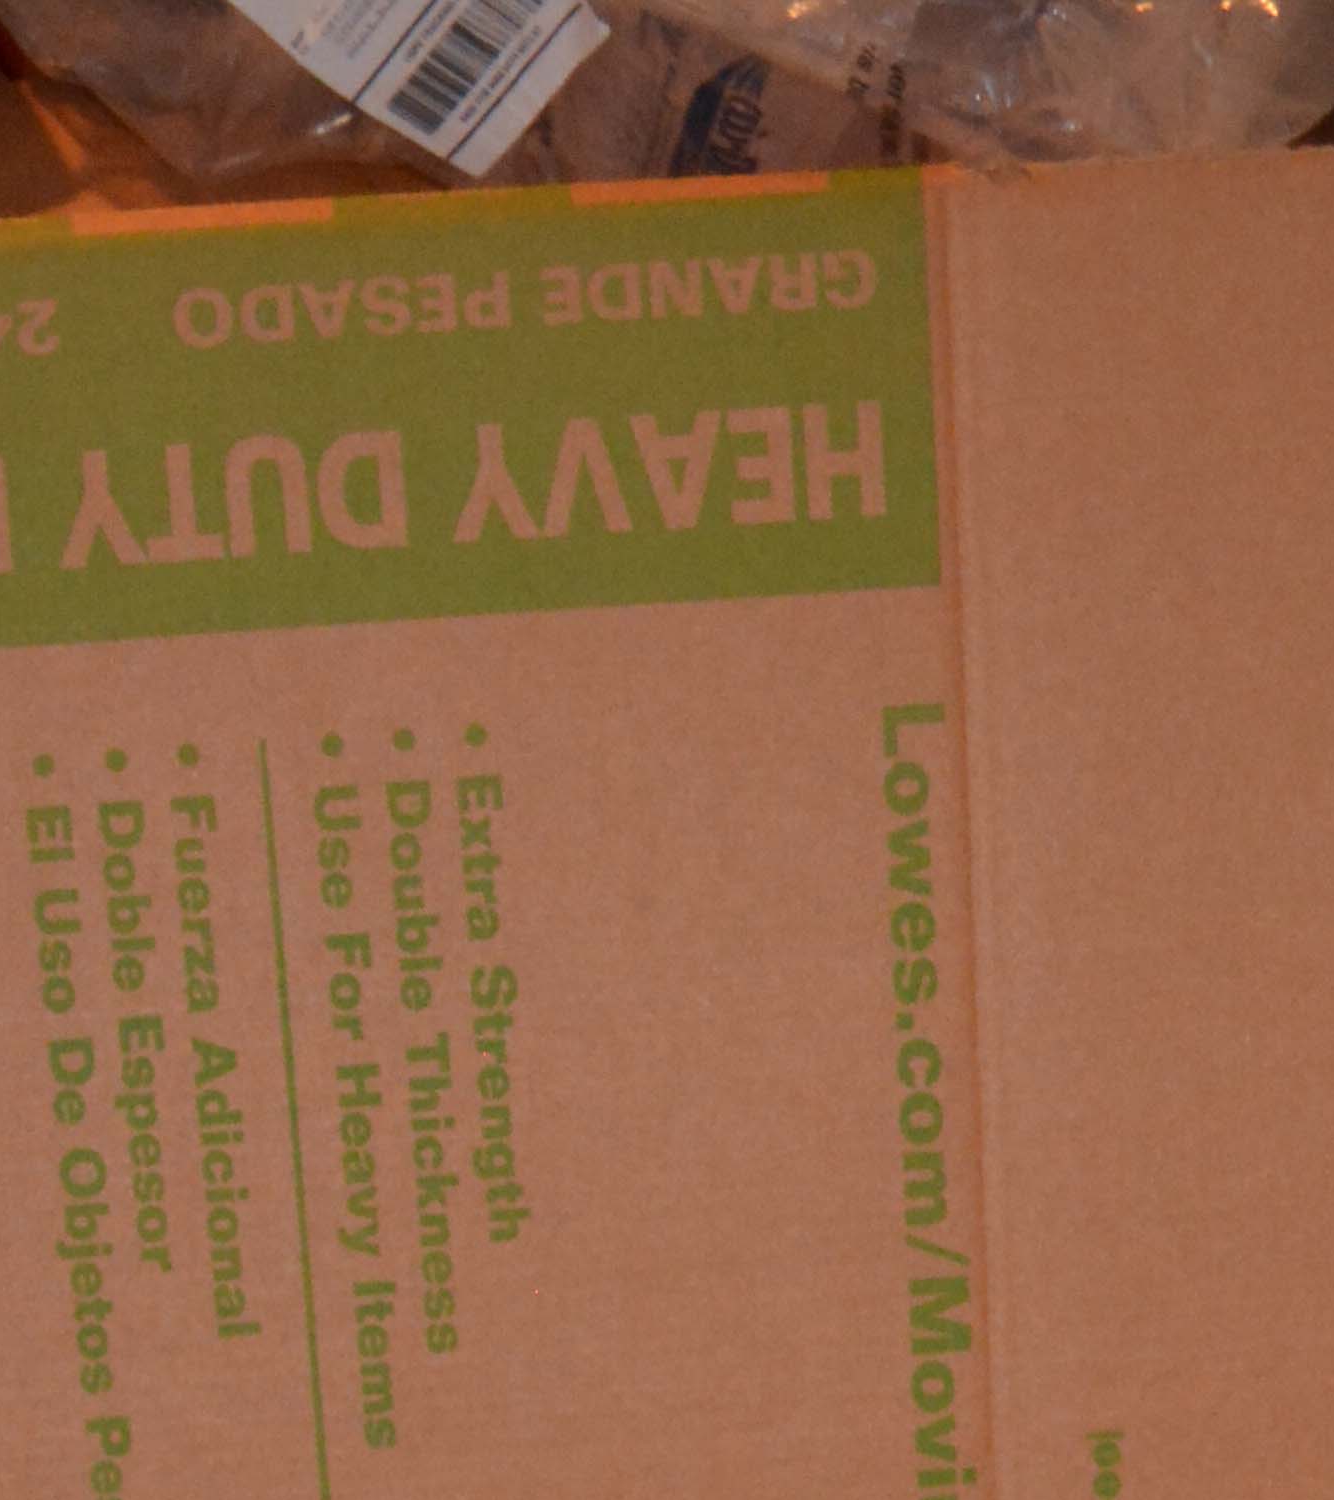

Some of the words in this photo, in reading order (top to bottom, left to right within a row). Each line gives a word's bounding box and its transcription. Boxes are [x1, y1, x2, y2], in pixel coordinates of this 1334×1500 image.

[171, 268, 513, 350] PESADO
[542, 249, 880, 320] GRANDE
[62, 432, 406, 571] DUTY
[456, 402, 886, 545] HEAVY
[25, 805, 75, 864] El
[97, 799, 156, 993] Doble
[168, 793, 221, 1014] Fuerza
[313, 783, 363, 910] Use
[385, 778, 444, 1013] Double
[455, 773, 505, 943] Extra
[32, 887, 81, 1015] Uso
[322, 931, 373, 1042] For
[46, 1036, 95, 1126] De
[114, 1014, 173, 1272] Espesor
[334, 1062, 384, 1259] Heavy
[468, 962, 533, 1243] Strength
[56, 1148, 115, 1396] Objetos
[190, 1036, 262, 1340] Adicional
[404, 1031, 460, 1356] Thickness
[351, 1279, 399, 1450] Items
